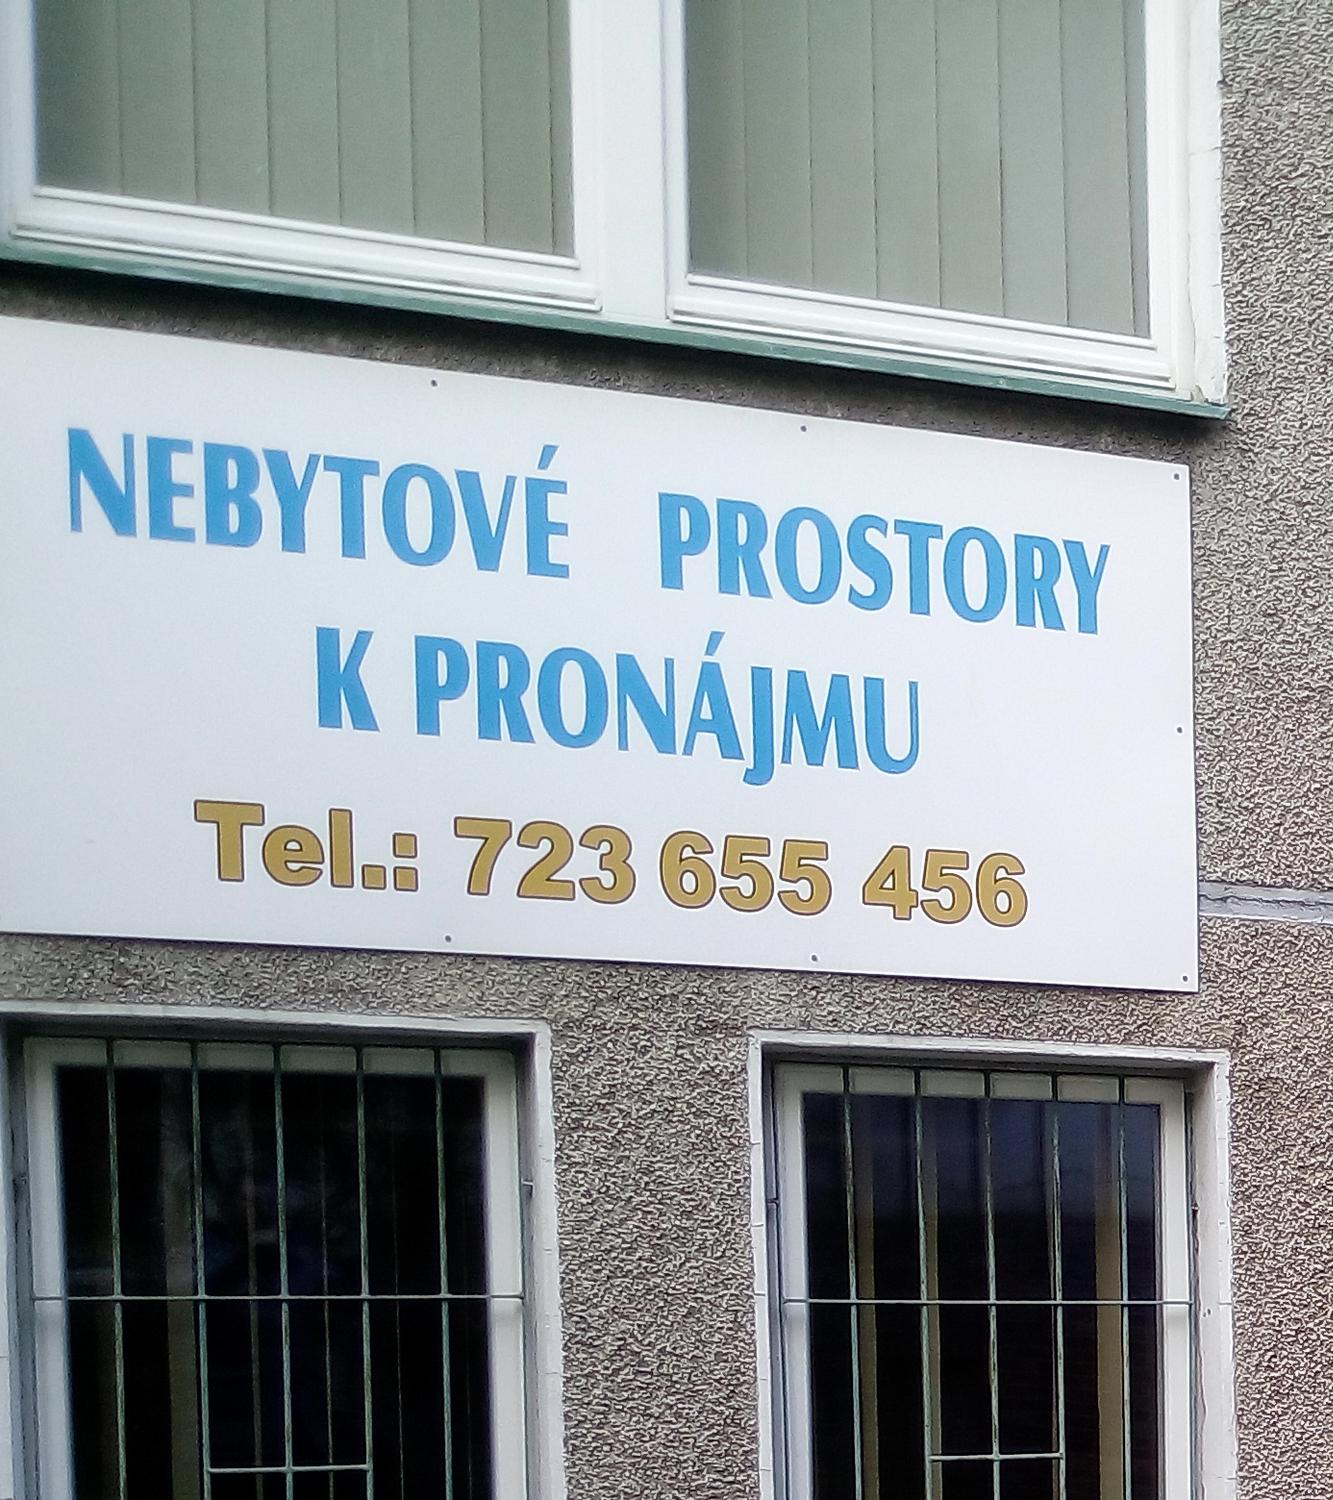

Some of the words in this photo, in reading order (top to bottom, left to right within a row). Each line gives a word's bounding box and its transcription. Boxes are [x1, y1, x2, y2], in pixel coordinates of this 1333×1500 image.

[66, 427, 571, 581] NEBYTOVÉ
[657, 491, 1111, 636] PROSTORY
[314, 627, 380, 732] K
[414, 632, 921, 786] PRONÁJMU
[194, 800, 420, 893] Tel.:
[454, 816, 637, 906] 723
[659, 830, 833, 918] 655
[861, 844, 1030, 929] 456
